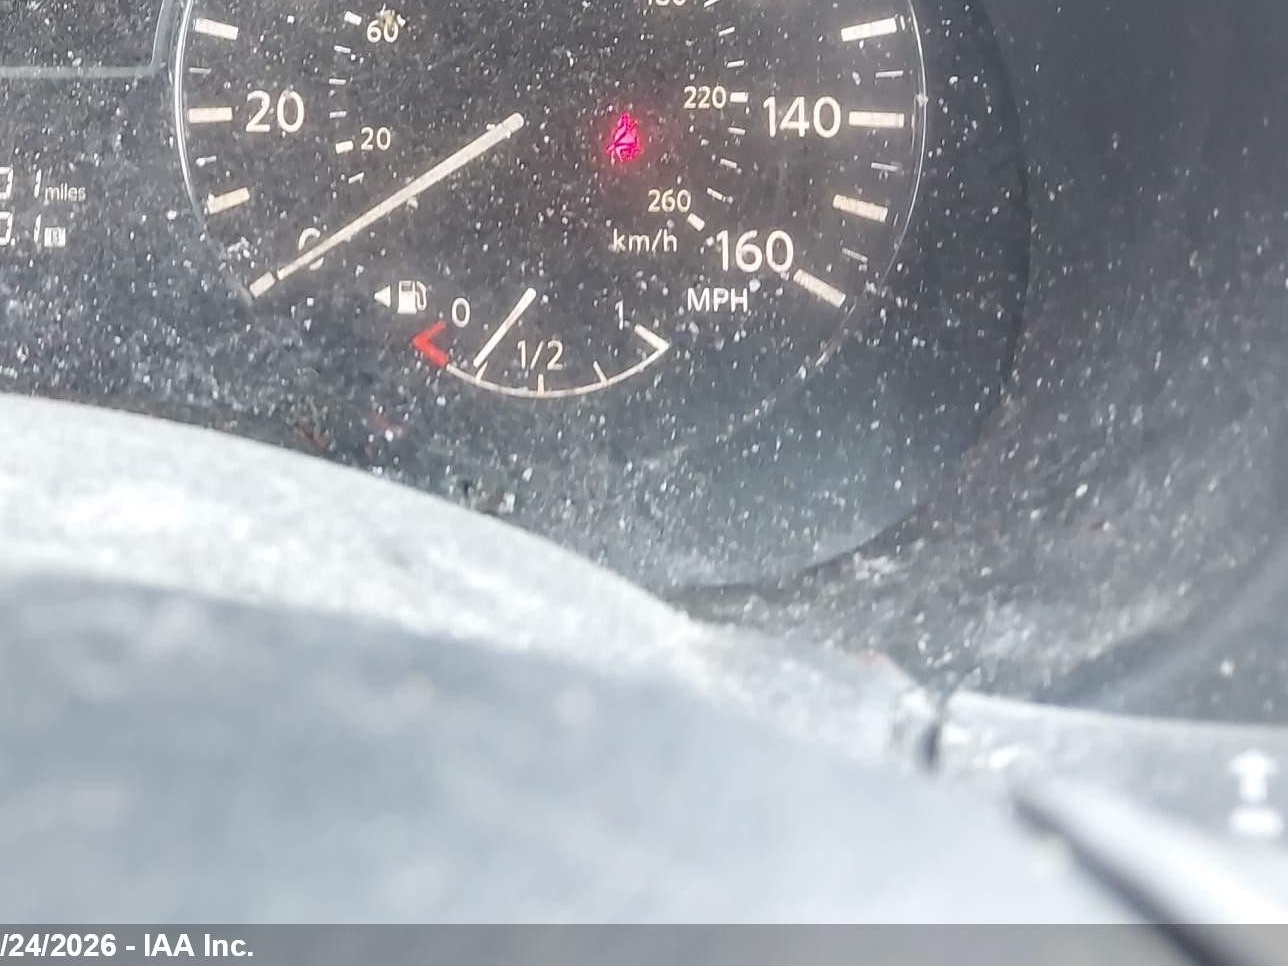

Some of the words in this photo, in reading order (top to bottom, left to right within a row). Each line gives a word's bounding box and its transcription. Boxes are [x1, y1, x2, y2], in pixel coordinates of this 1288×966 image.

[366, 20, 399, 44] 60
[683, 86, 727, 110] 220
[246, 91, 305, 132] 20
[763, 98, 841, 137] 140
[361, 127, 392, 150] 20
[45, 183, 87, 202] miles
[647, 189, 692, 213] 260
[613, 228, 678, 254] km/h
[717, 230, 793, 272] 160
[451, 298, 470, 326] 0
[615, 300, 625, 327] 1
[688, 288, 748, 313] MPH
[518, 341, 564, 371] 1/2
